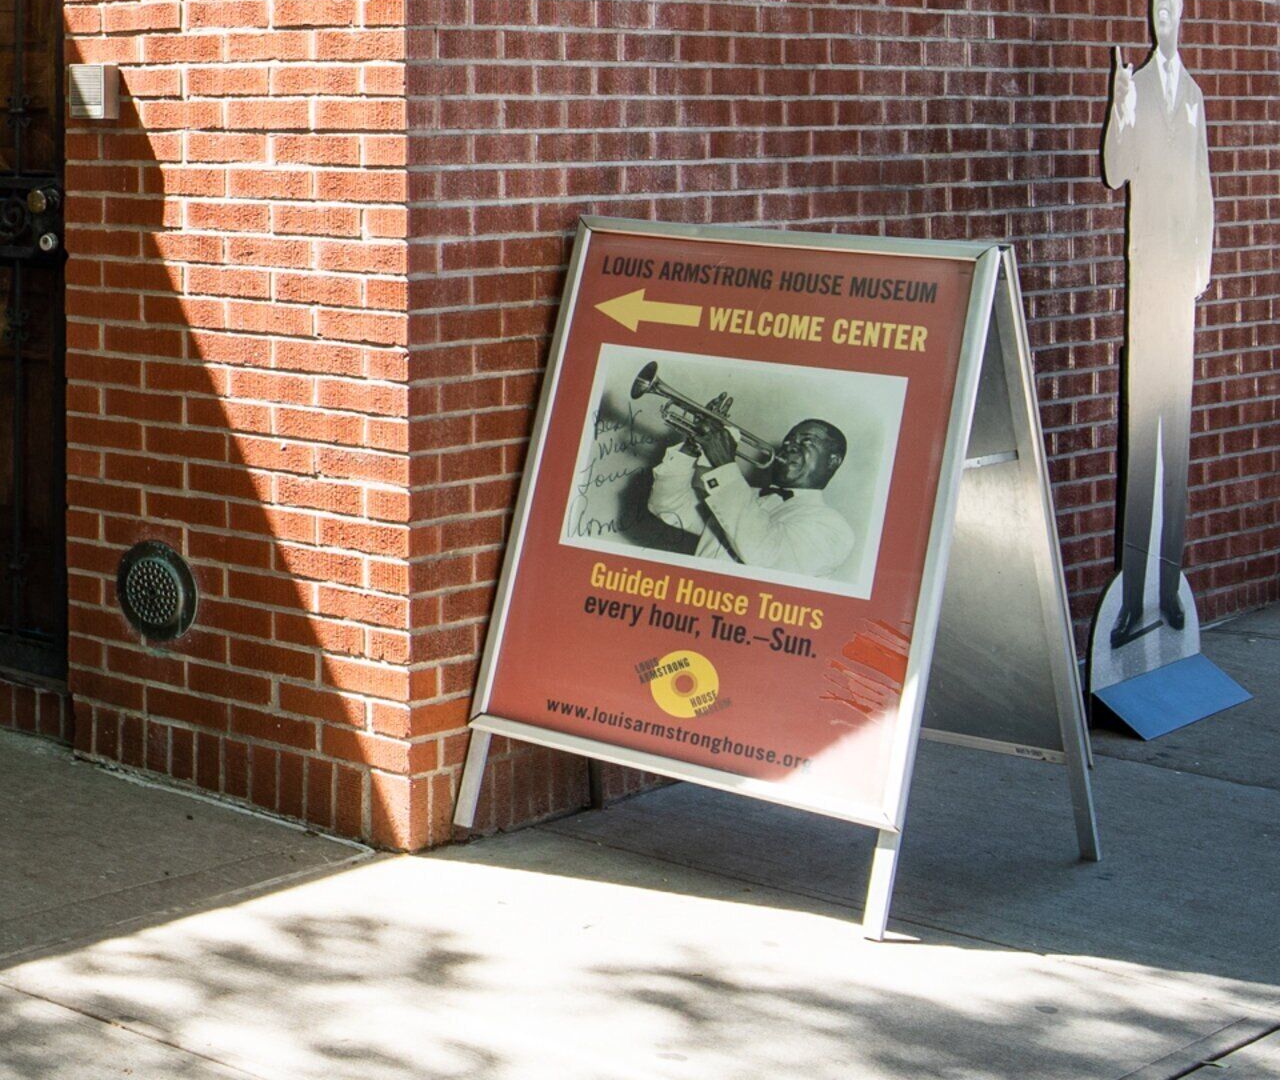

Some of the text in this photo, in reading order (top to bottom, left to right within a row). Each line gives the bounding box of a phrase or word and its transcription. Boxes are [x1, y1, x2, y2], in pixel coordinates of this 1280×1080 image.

[601, 255, 938, 305] LOUIS ARMSTRONG HOUSE MUSEUM
[709, 305, 929, 352] WELCOME CENTER
[583, 594, 644, 628] every
[648, 603, 702, 639] hour,
[590, 561, 825, 630] Guided House Tours
[634, 657, 660, 674] LOUIS
[639, 657, 690, 684] ARMSTRONG
[689, 690, 717, 708] HOUSE
